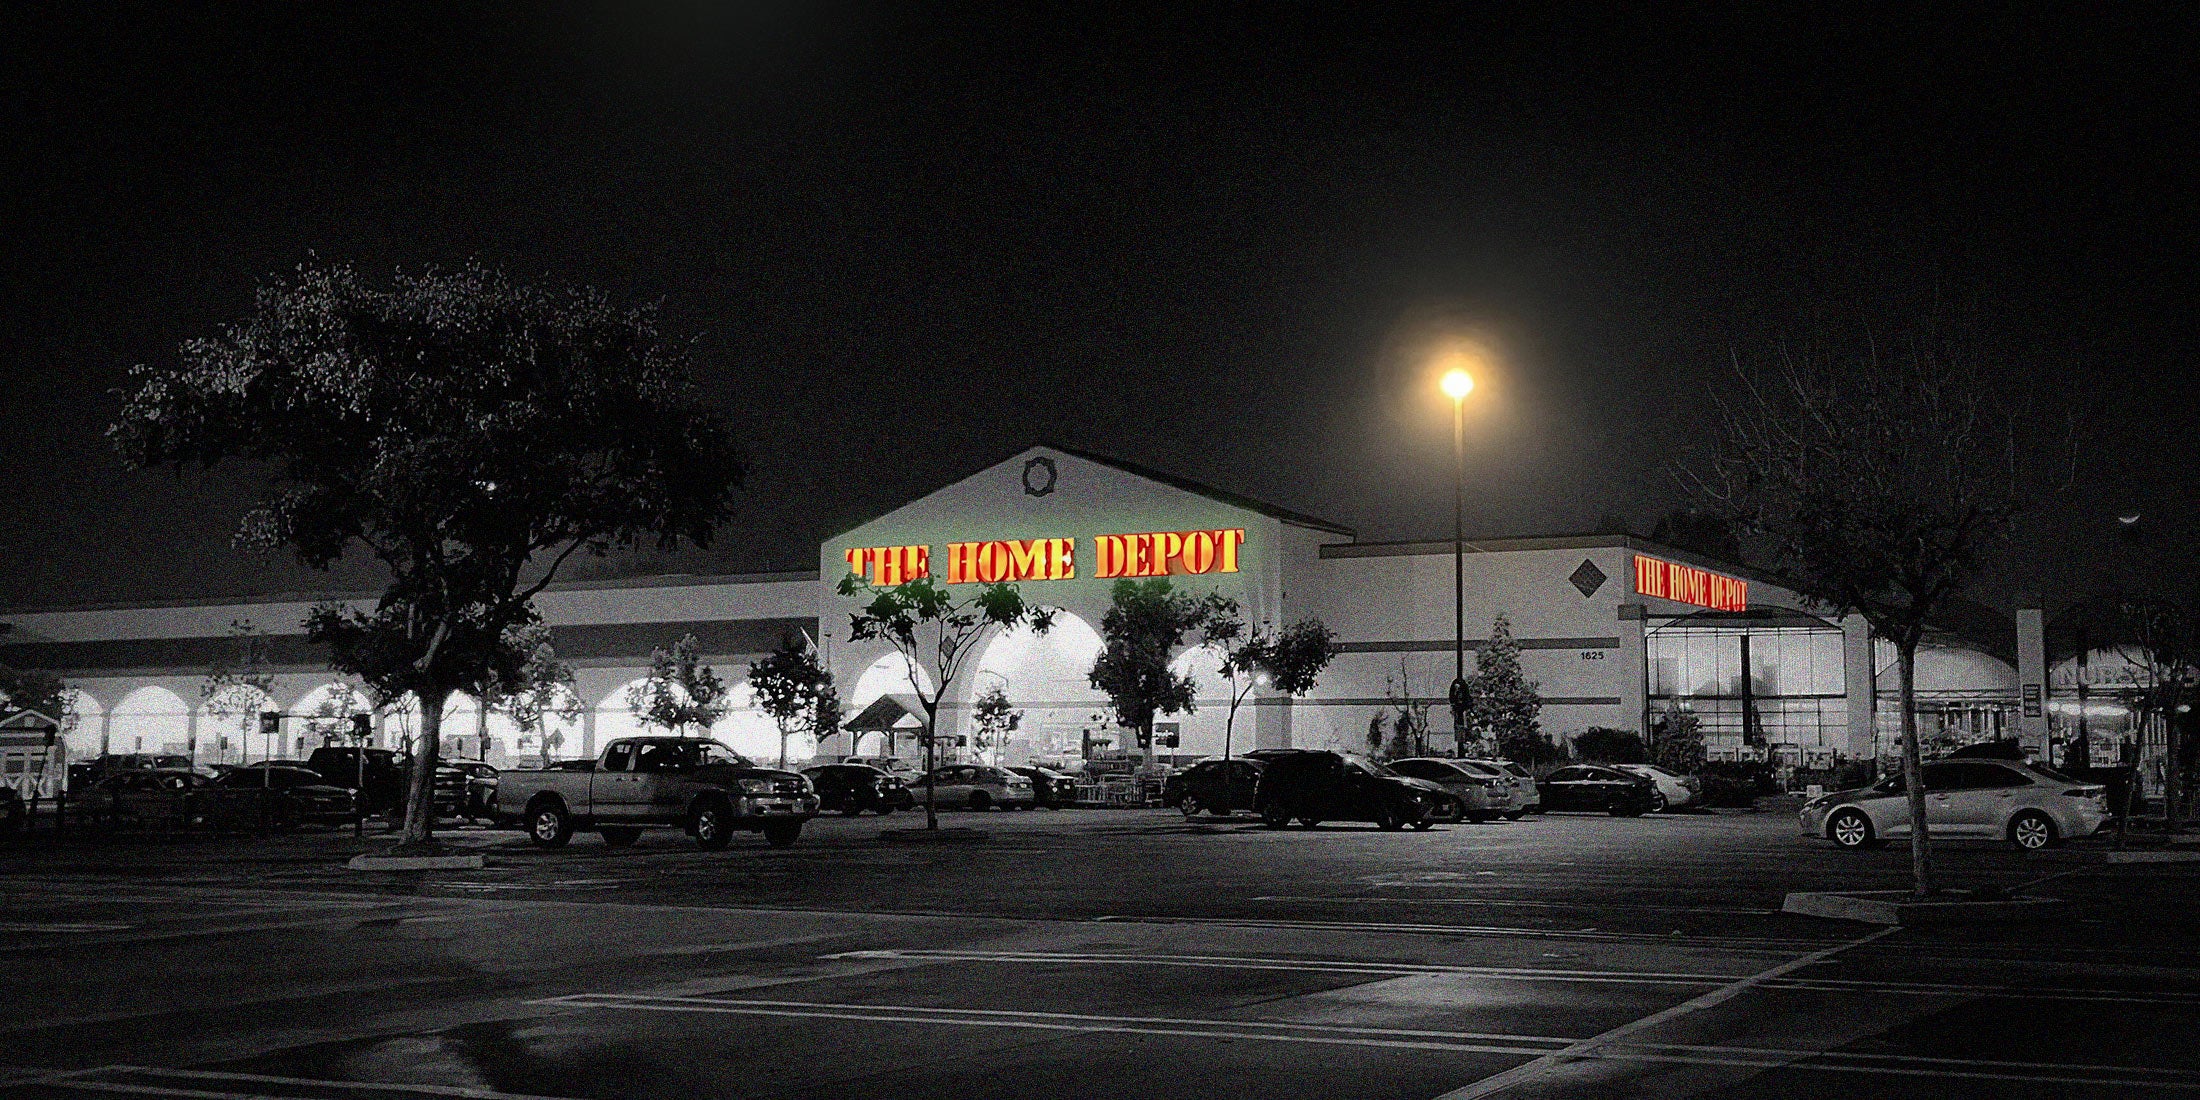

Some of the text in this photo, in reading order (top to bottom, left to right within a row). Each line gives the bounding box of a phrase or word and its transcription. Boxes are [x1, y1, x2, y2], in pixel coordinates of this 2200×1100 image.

[845, 528, 1245, 587] THE HOME DEPOT
[1634, 555, 1747, 612] THE HOME DEPOT
[1581, 651, 1604, 660] 1625
